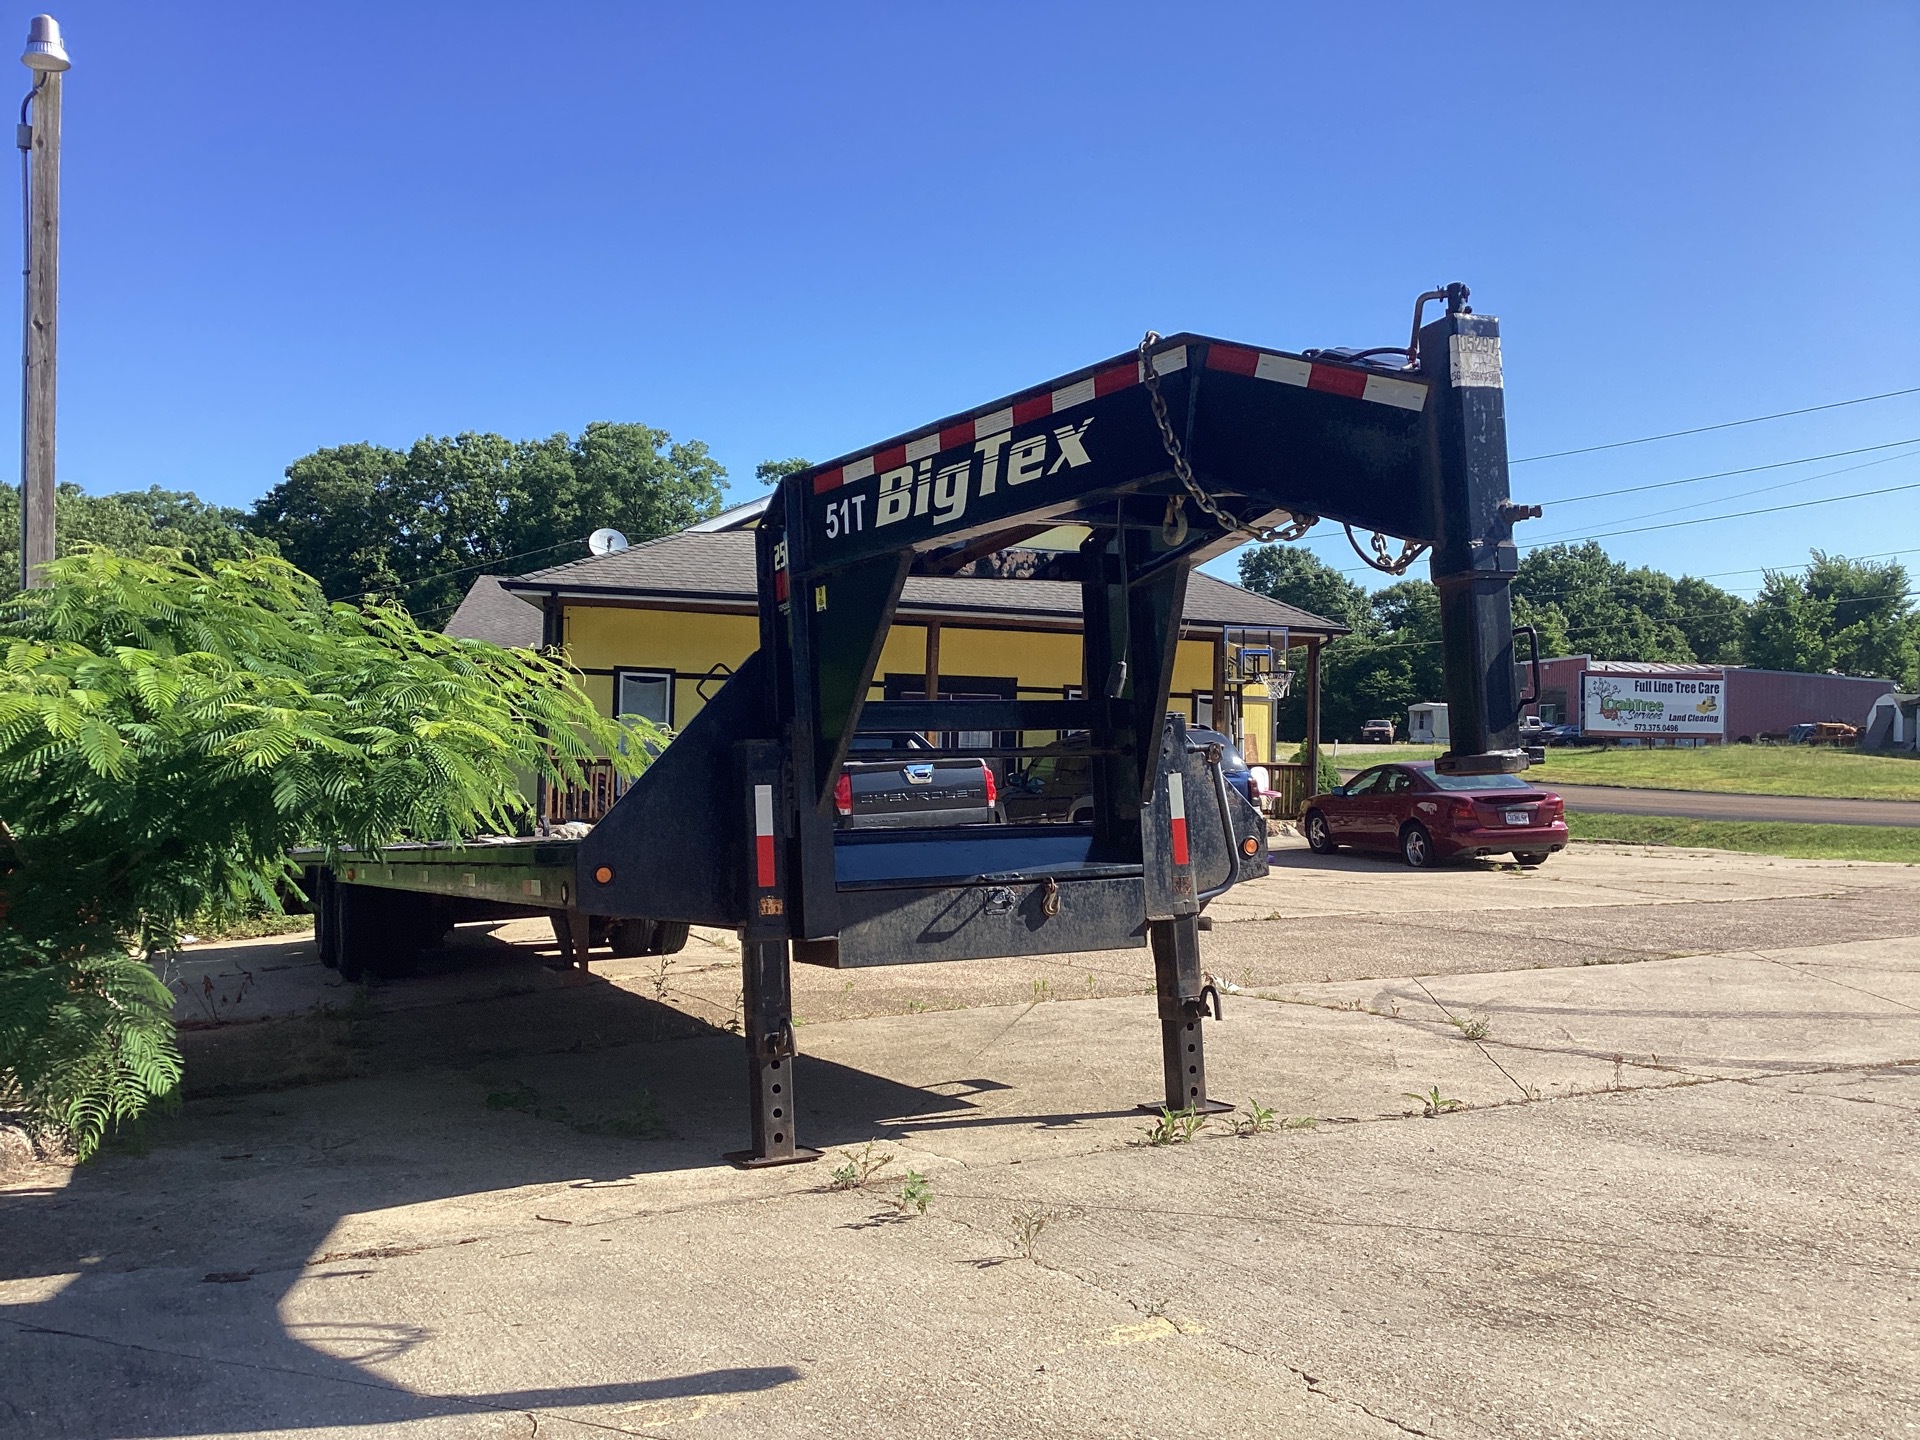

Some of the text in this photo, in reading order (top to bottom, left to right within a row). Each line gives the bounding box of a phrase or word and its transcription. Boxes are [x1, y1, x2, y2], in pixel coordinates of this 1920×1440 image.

[826, 495, 866, 539] 51T
[1634, 680, 1720, 695] Full Line Tree Care
[1626, 709, 1663, 720] Services
[1668, 713, 1719, 723] Land Clearing
[861, 789, 981, 803] CHEVROLET
